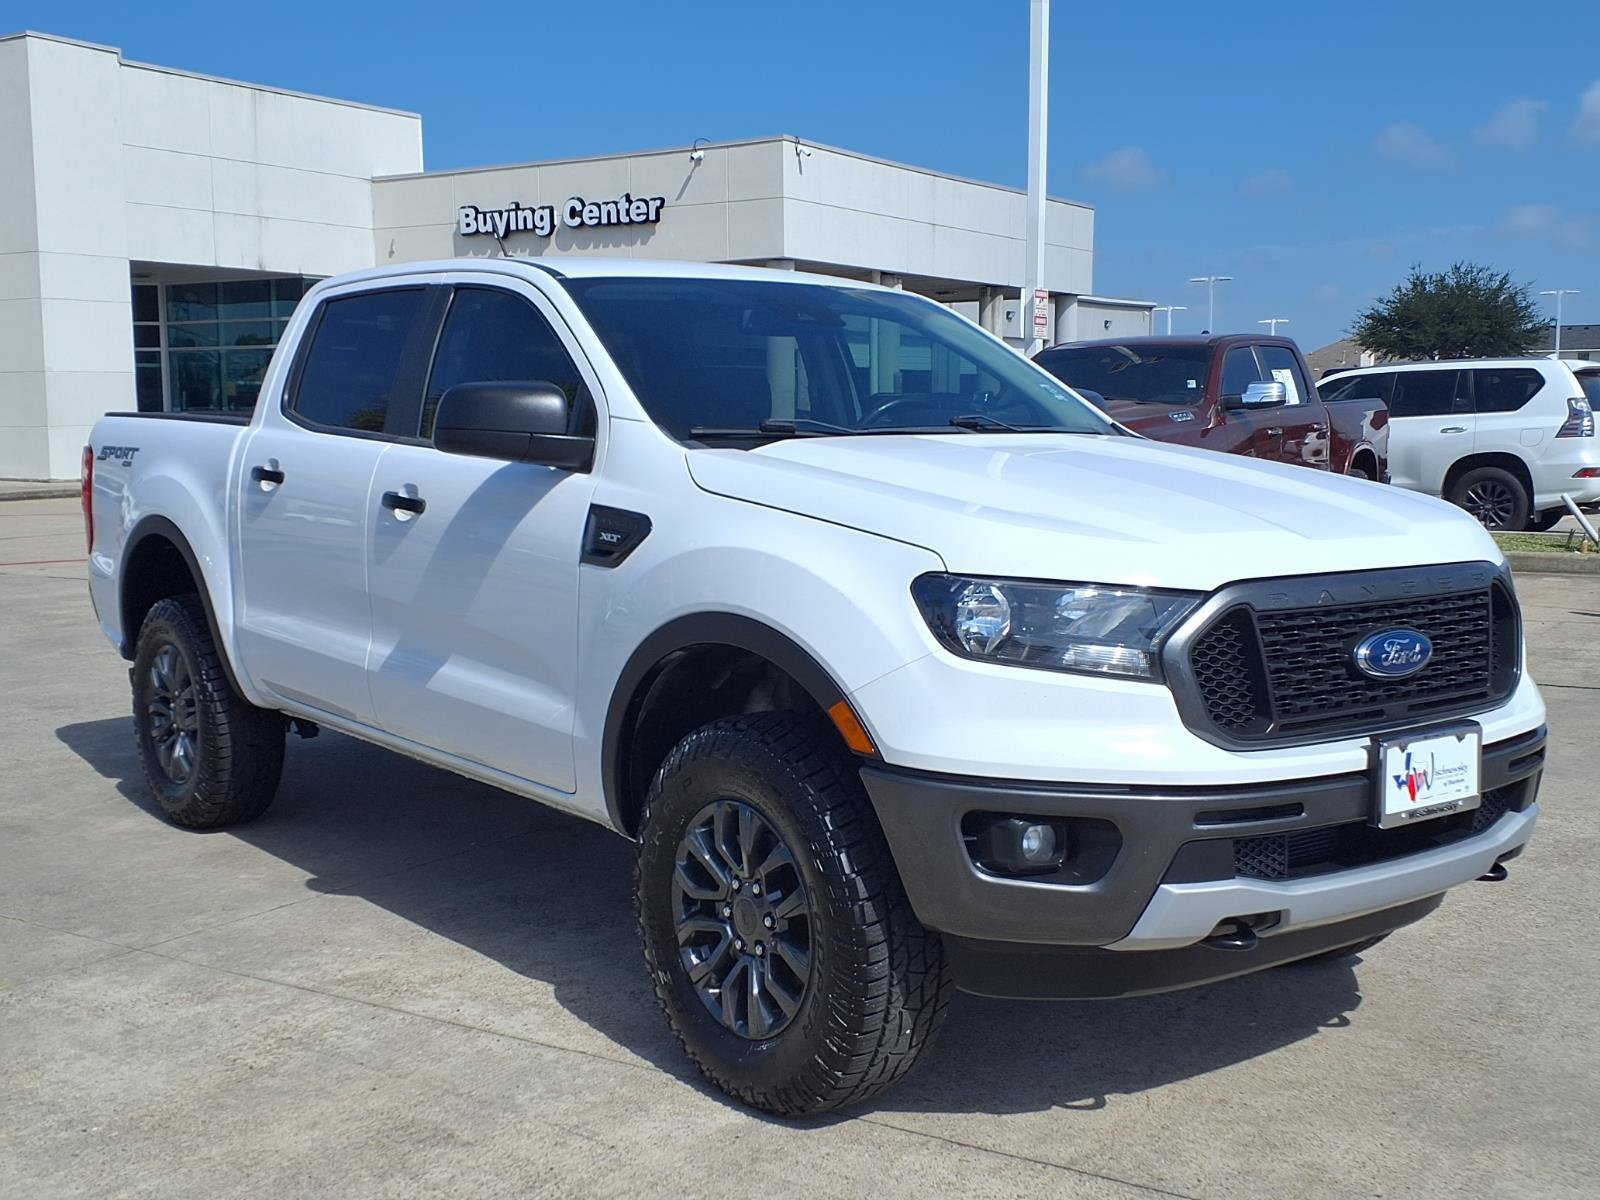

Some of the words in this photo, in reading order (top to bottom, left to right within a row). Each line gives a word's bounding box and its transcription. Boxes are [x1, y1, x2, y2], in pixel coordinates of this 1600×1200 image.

[459, 202, 554, 239] Buying
[562, 193, 664, 228] Center
[97, 446, 140, 461] SPORT
[600, 532, 621, 543] XLT
[1382, 638, 1421, 666] Ford
